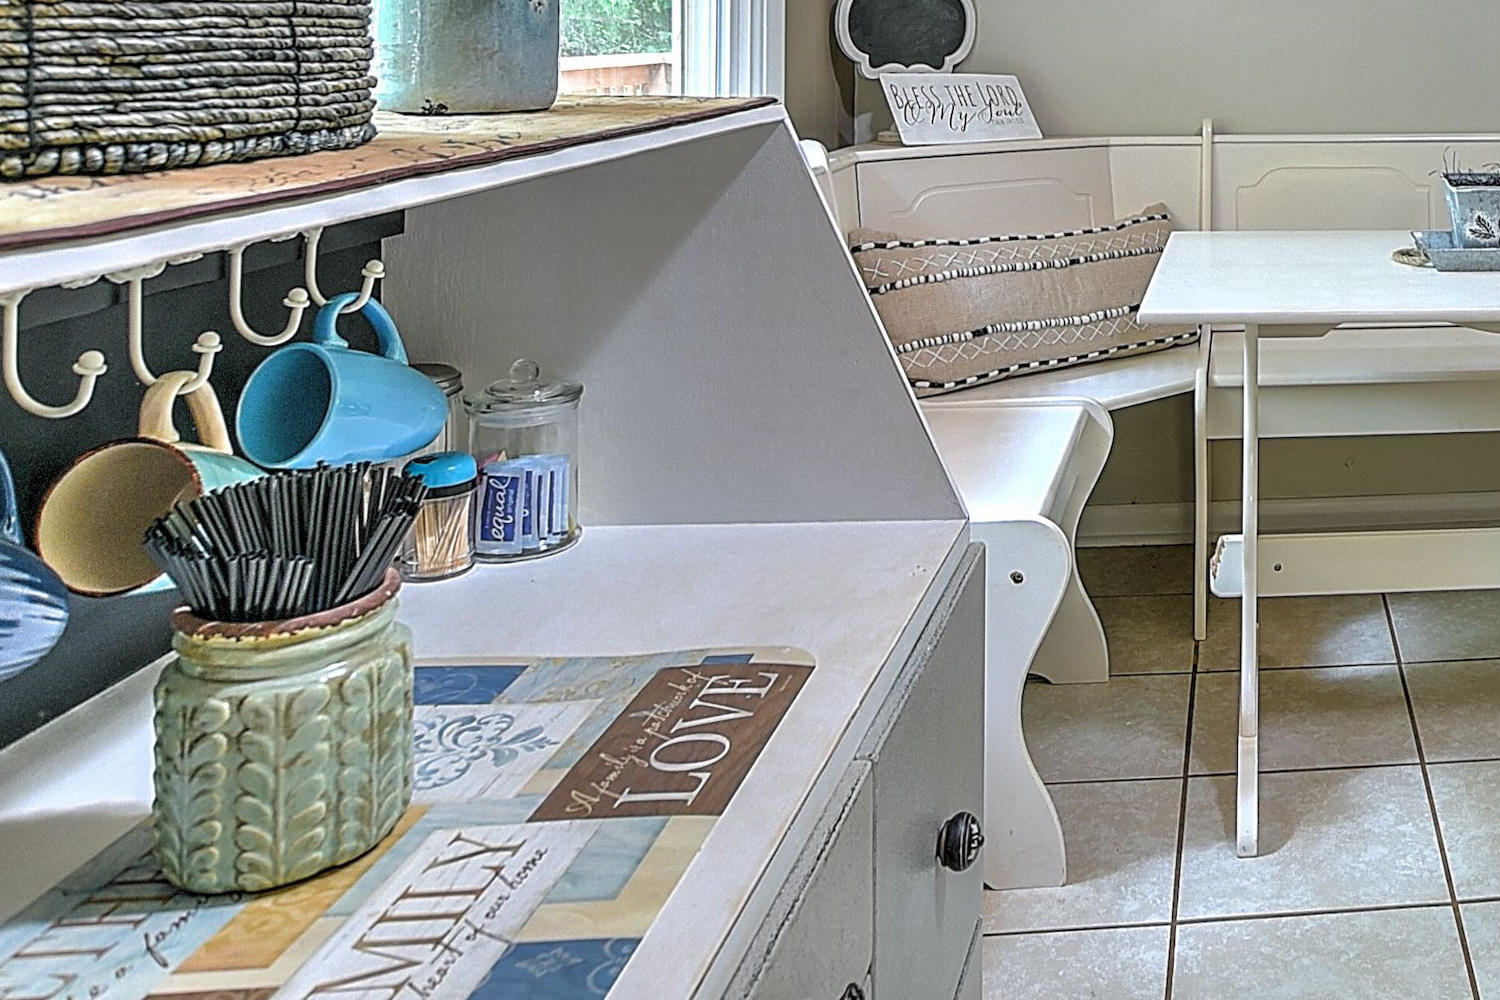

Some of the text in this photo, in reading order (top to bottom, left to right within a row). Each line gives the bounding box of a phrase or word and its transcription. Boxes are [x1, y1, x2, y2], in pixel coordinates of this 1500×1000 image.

[890, 84, 941, 109] BLESS
[944, 85, 977, 107] THE
[489, 476, 514, 541] equal
[565, 789, 600, 816] A
[590, 752, 649, 798] family
[636, 736, 648, 745] a
[613, 671, 779, 809] LOVE
[407, 846, 549, 998] heart of our home
